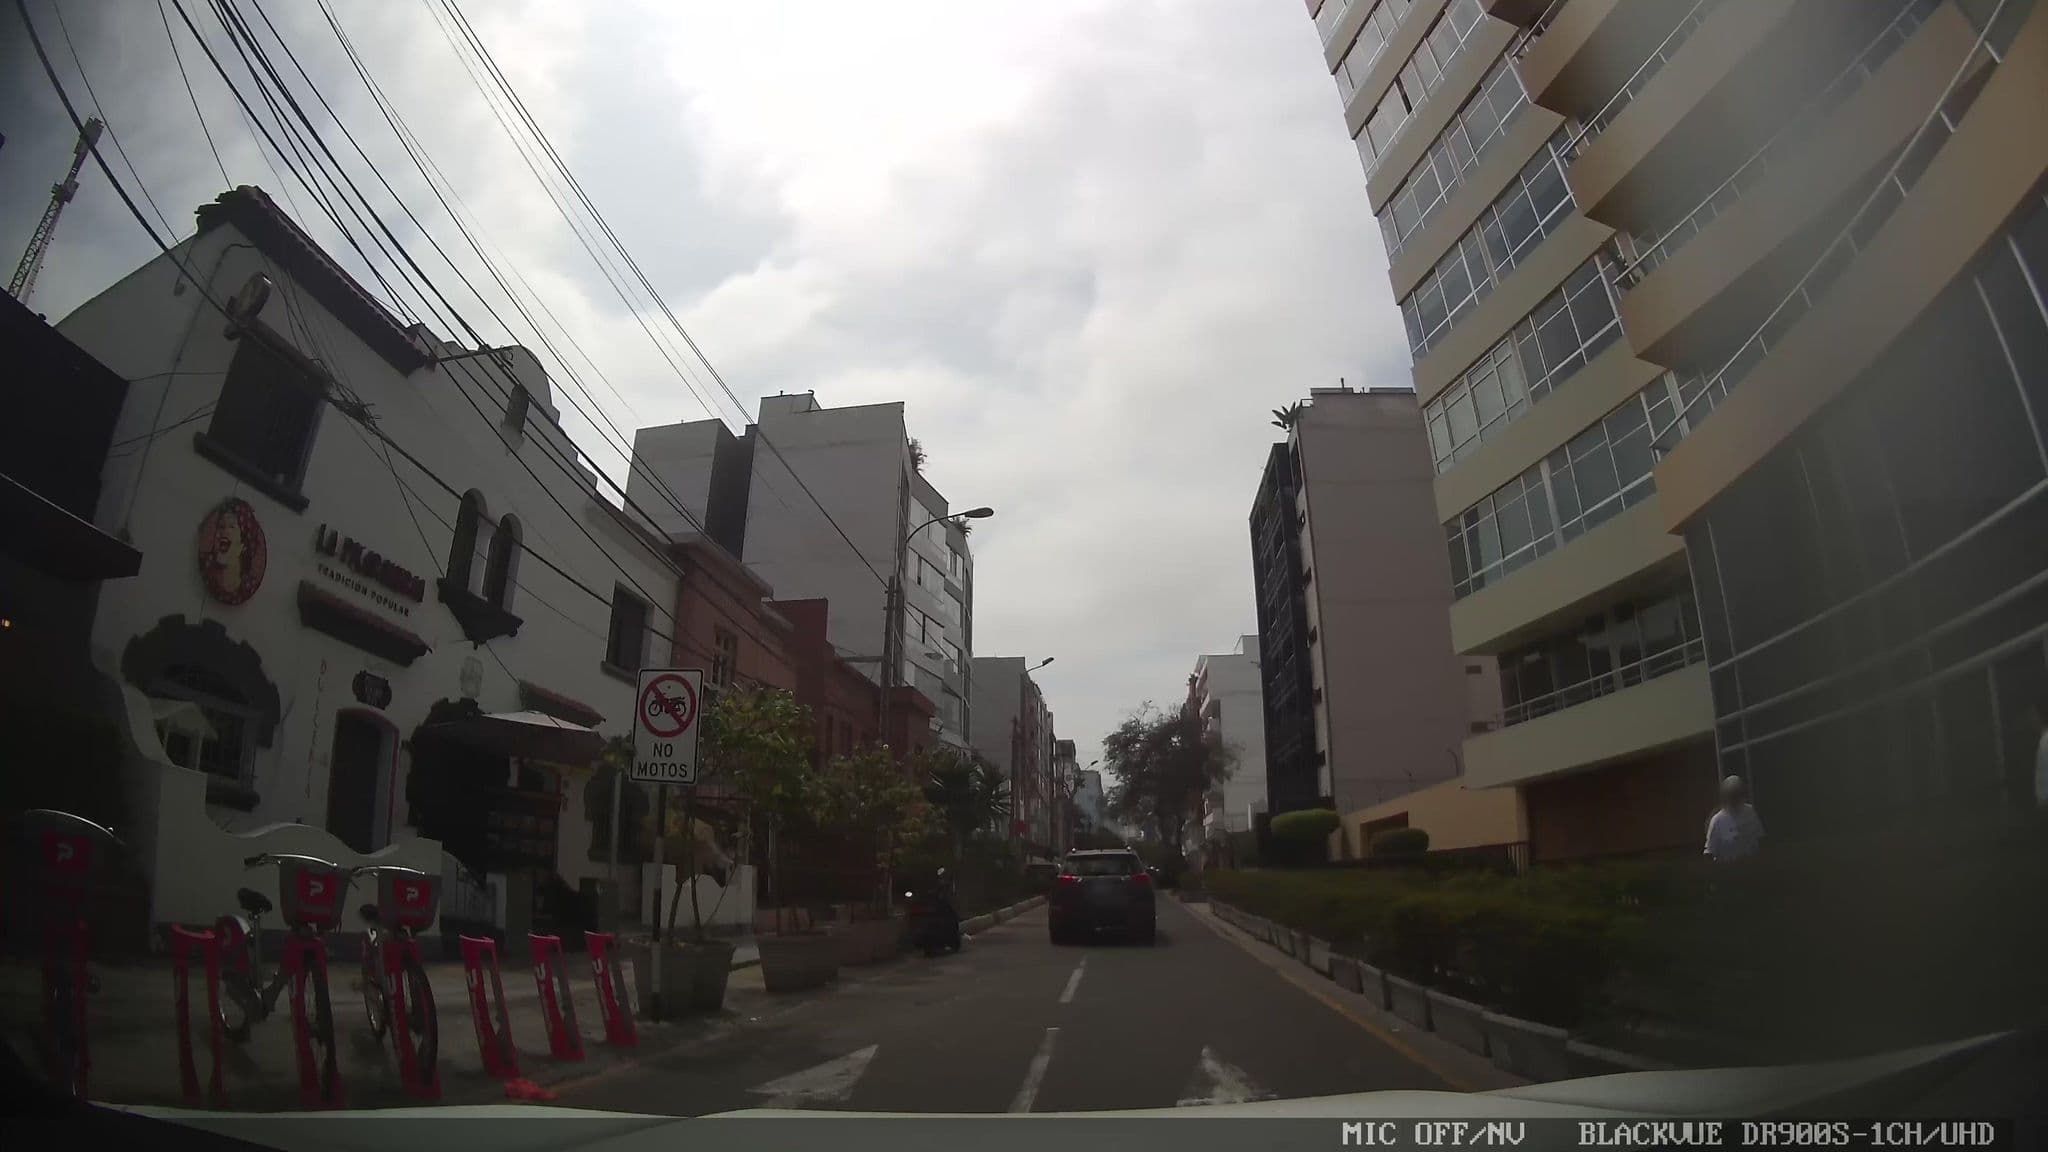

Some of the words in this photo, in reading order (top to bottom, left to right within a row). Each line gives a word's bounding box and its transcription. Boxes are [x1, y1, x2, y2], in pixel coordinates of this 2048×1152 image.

[371, 591, 409, 617] POPULAR
[653, 743, 673, 758] NO
[637, 761, 688, 778] MOTOS
